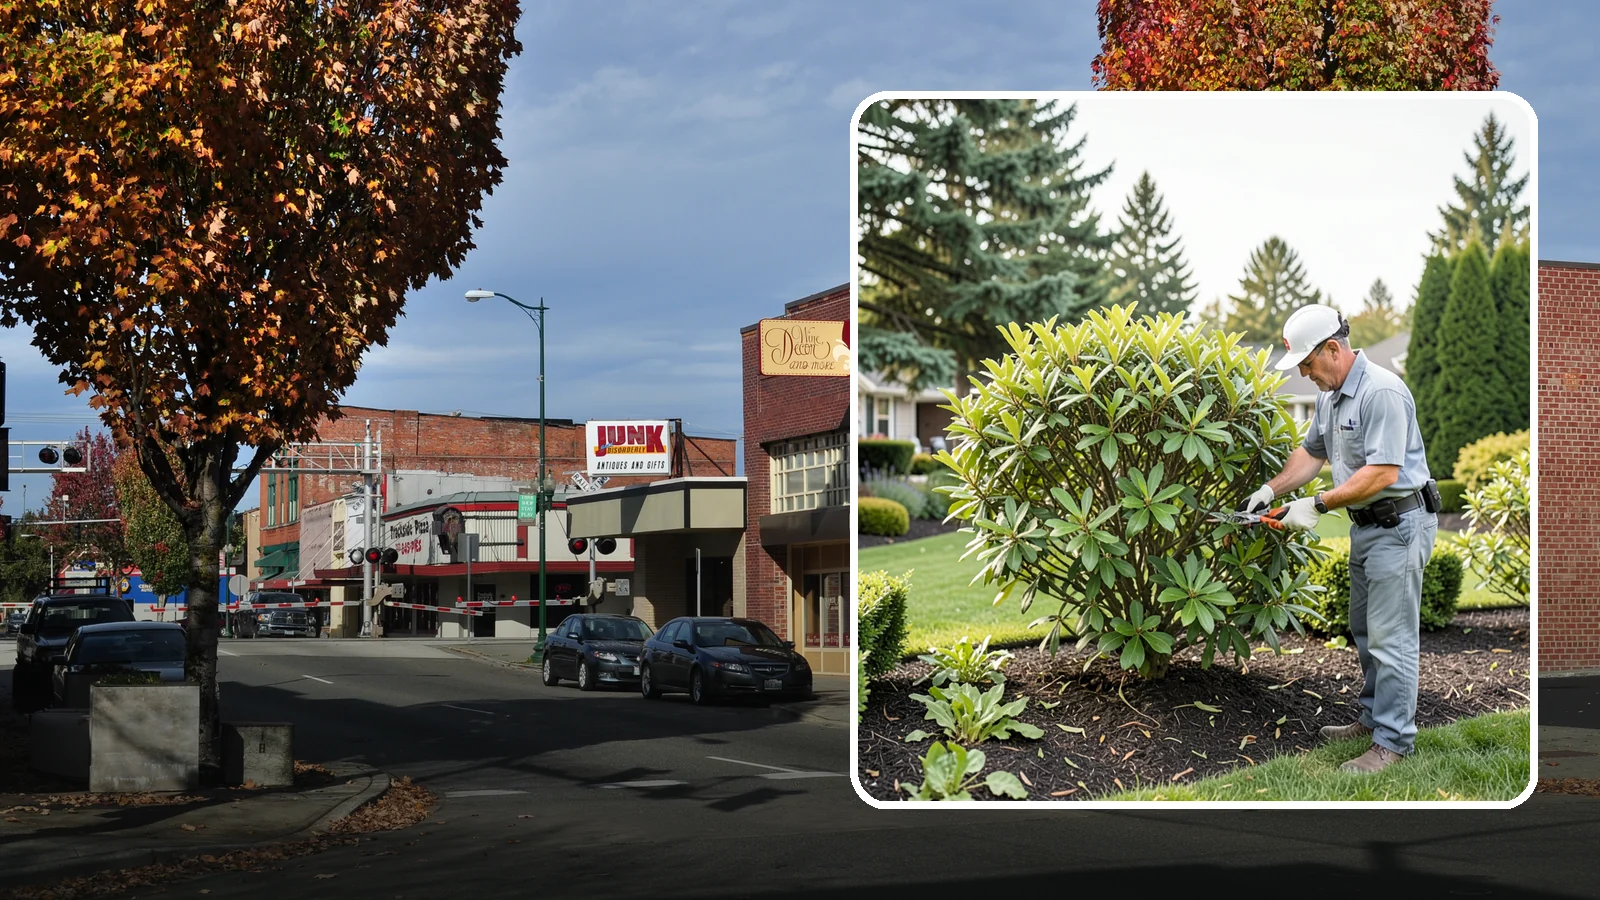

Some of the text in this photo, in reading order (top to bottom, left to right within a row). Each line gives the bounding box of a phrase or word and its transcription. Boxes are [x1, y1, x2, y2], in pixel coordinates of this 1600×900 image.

[765, 328, 831, 365] Decor
[595, 425, 665, 457] JUNK
[597, 460, 665, 470] ANTIQUES AND GIFTS
[390, 519, 429, 539] Trackside Pizza
